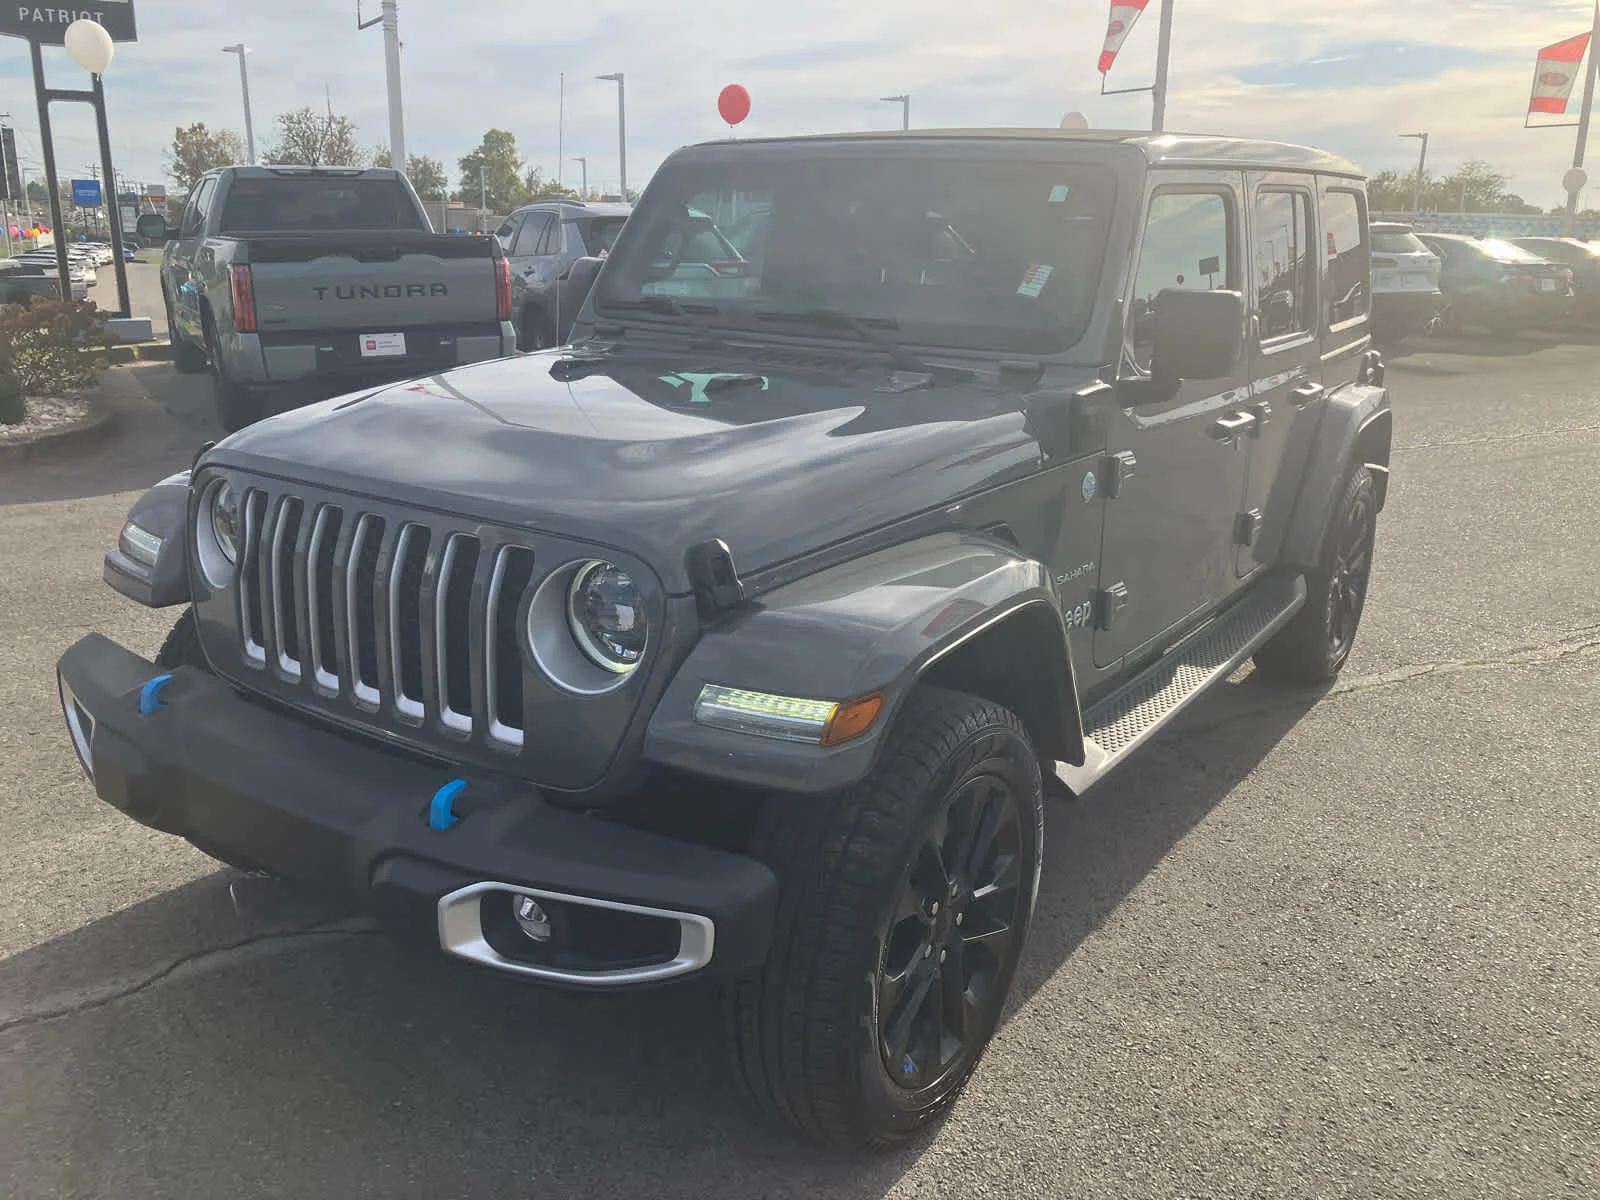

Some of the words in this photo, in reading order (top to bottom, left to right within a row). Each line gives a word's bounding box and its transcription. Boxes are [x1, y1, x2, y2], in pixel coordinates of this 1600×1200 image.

[19, 7, 104, 24] PATRIOT
[312, 283, 448, 300] TUNDRA
[1056, 562, 1096, 584] SAHARA
[1065, 600, 1092, 629] eep
